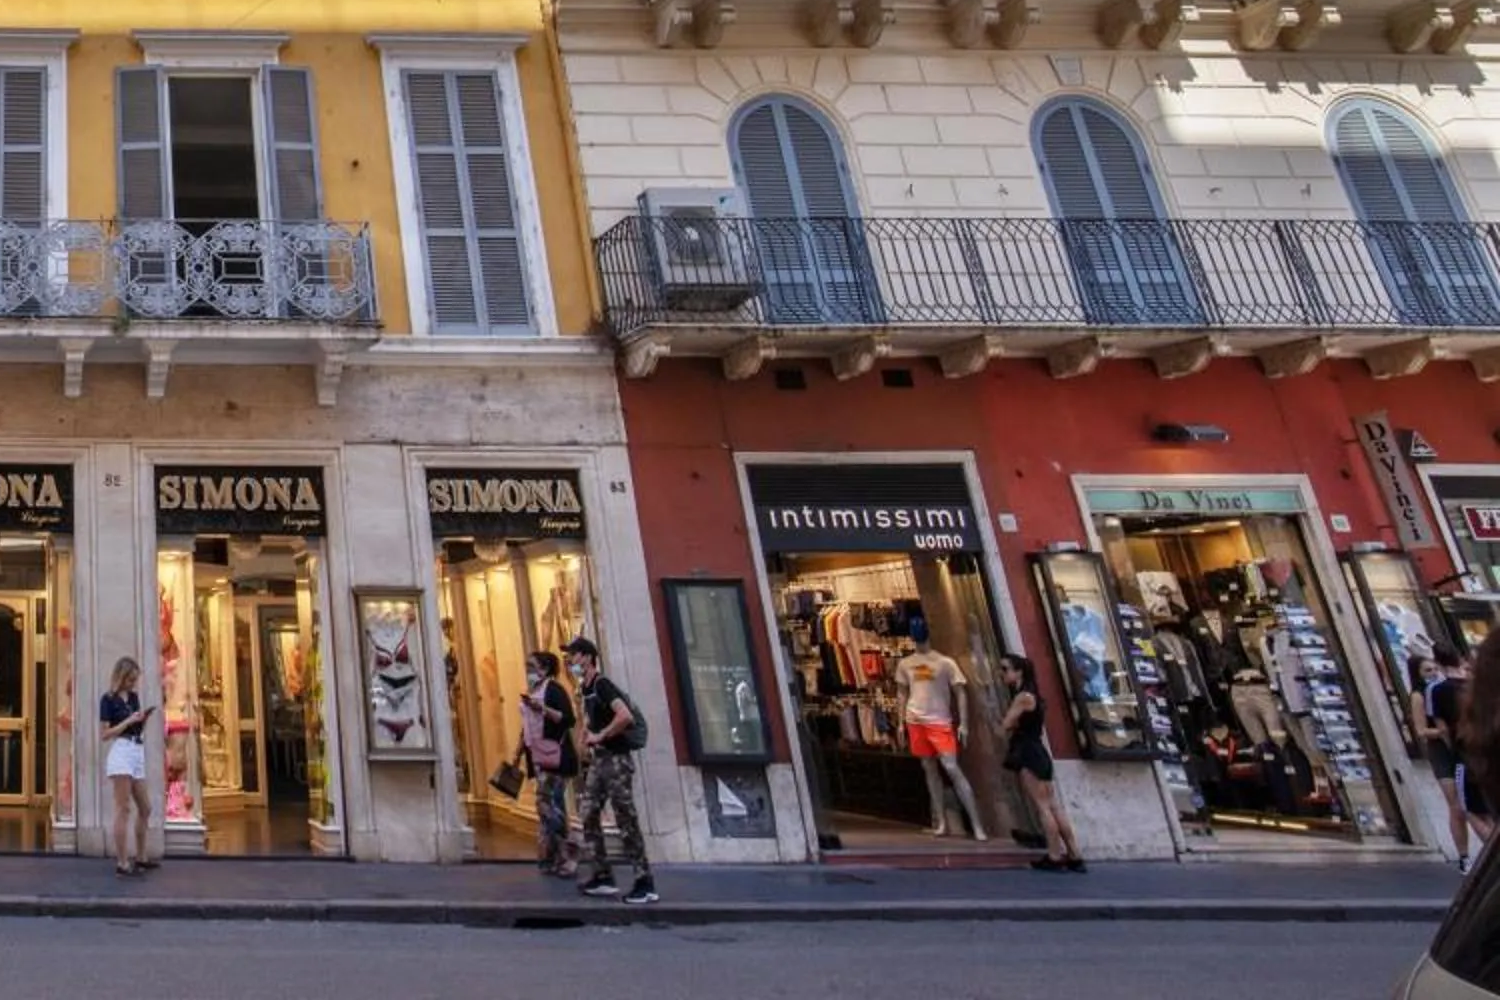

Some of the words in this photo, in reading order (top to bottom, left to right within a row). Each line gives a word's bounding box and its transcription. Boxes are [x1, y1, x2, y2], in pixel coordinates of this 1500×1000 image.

[159, 475, 320, 511] SIMONA
[428, 479, 581, 513] SIMONA
[1139, 490, 1174, 509] Da
[1186, 490, 1254, 510] Vinci
[1379, 455, 1421, 541] Vinci
[769, 505, 966, 528] intimissimi
[914, 533, 963, 549] uomo
